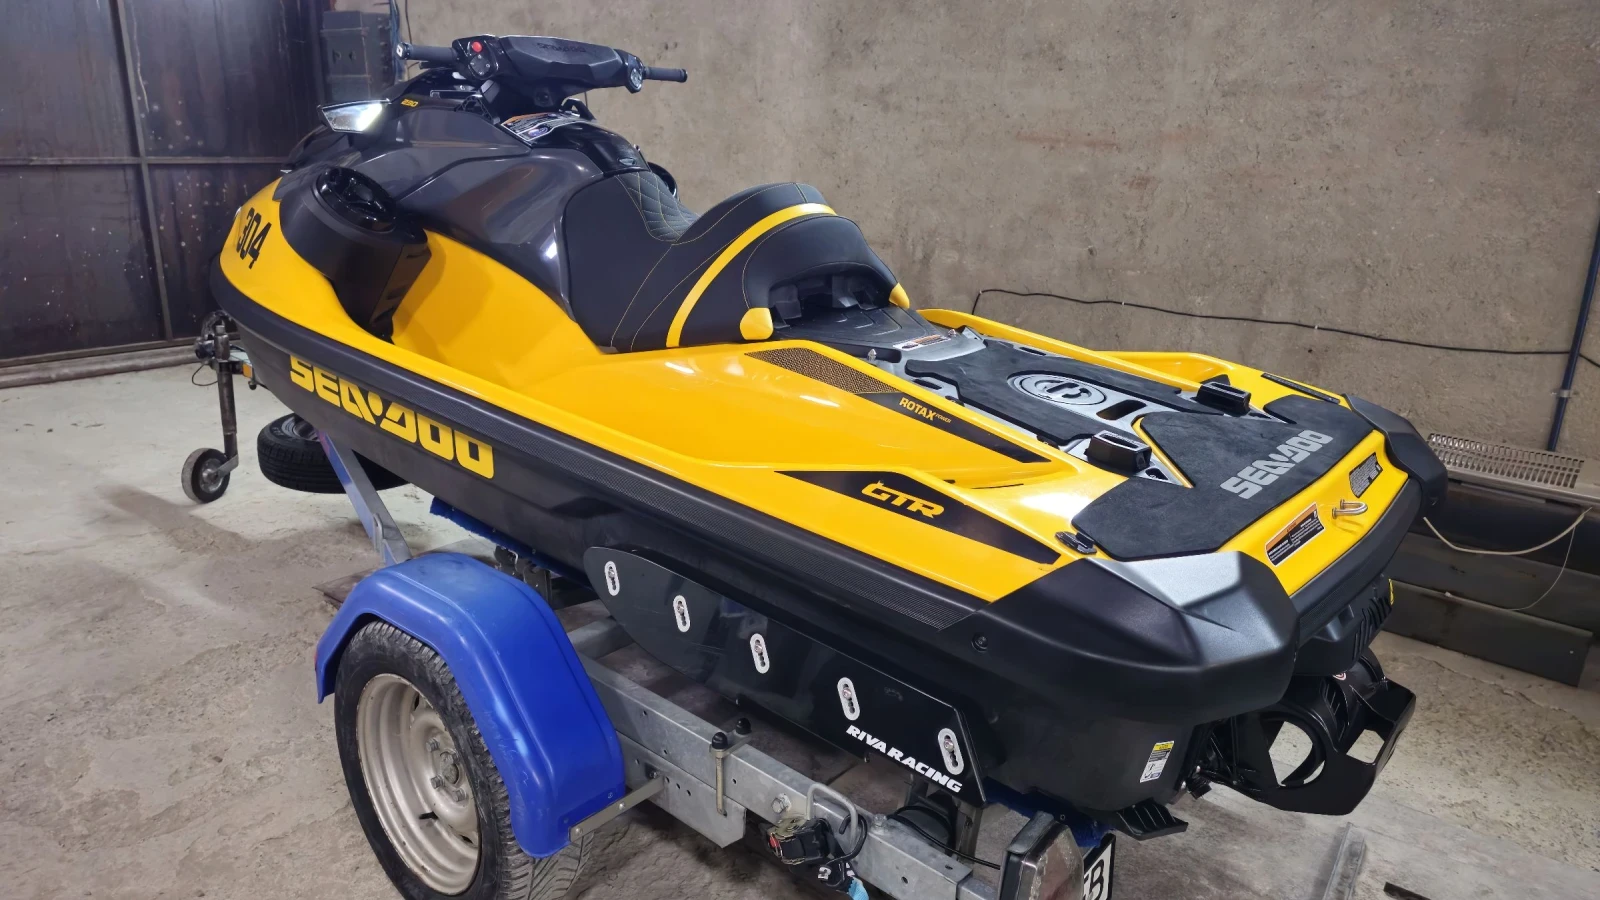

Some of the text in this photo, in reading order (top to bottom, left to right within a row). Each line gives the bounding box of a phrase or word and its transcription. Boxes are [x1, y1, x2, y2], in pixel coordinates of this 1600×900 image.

[236, 207, 272, 270] 304
[899, 397, 937, 421] ROTAX
[861, 480, 945, 519] GTR
[846, 724, 963, 793] RIVA RACING
